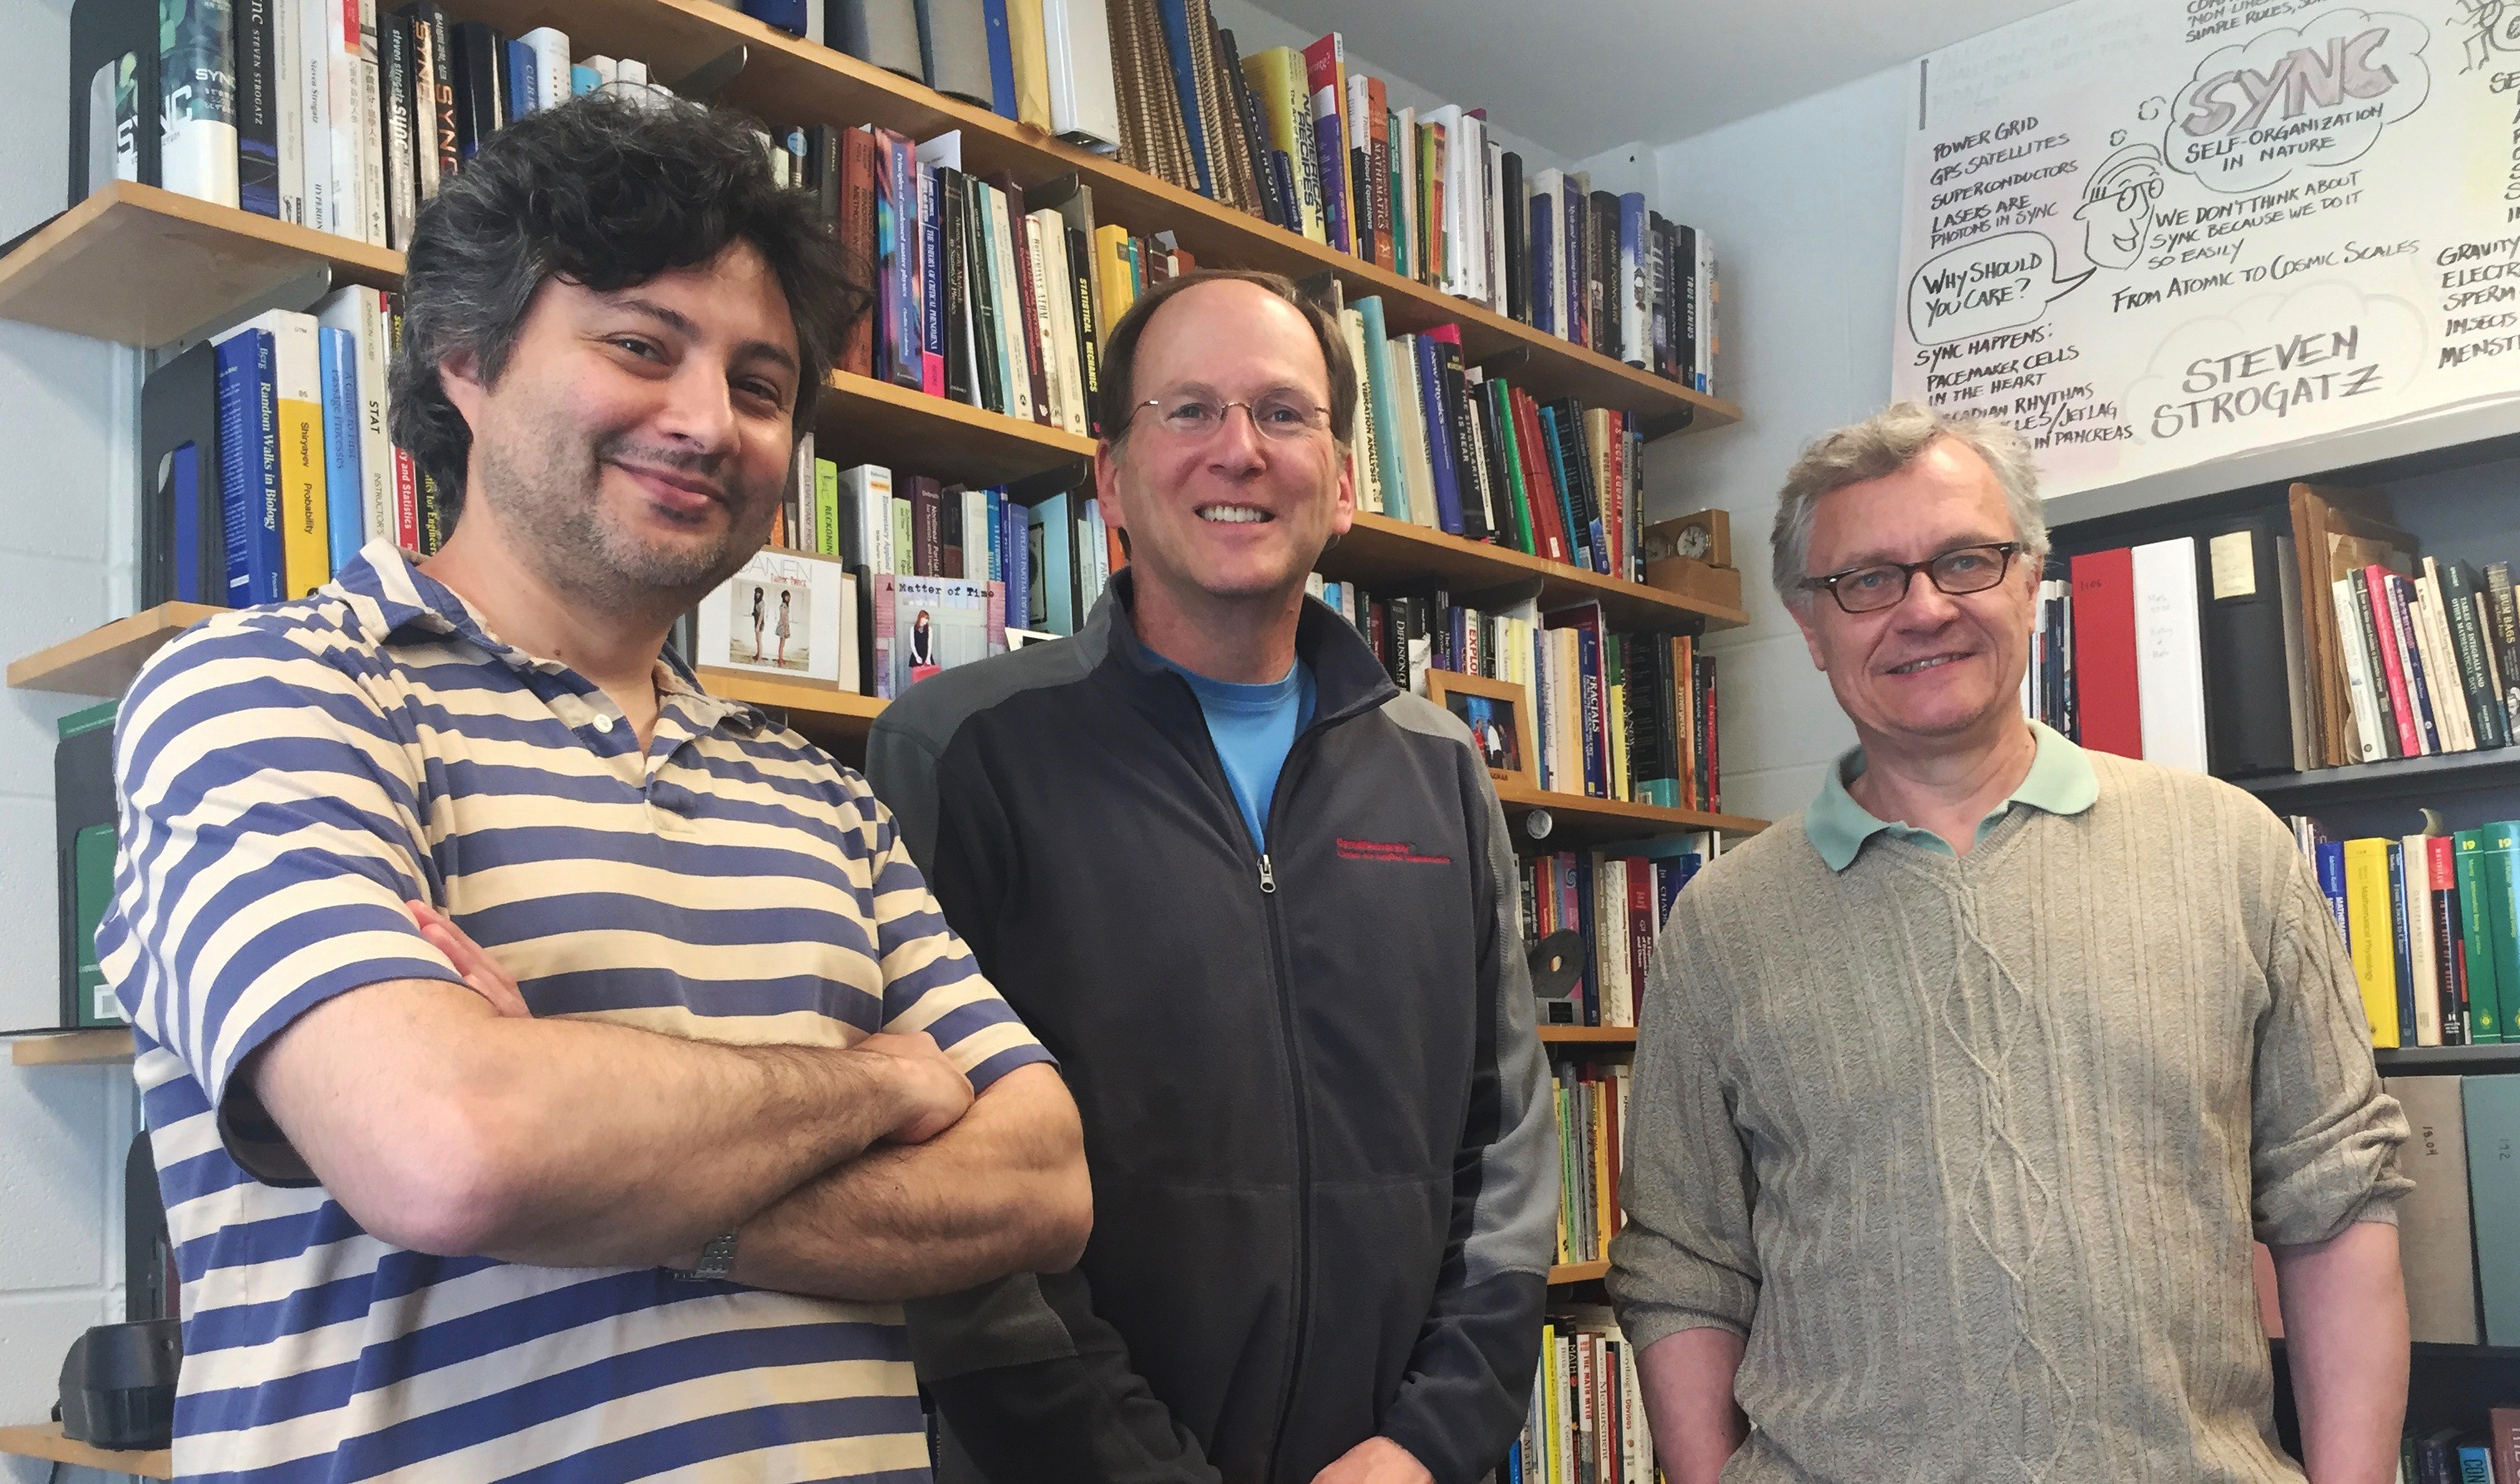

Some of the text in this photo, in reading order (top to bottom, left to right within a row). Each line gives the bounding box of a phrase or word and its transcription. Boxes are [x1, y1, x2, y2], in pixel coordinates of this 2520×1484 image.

[2185, 2, 2296, 42] SIMPLE RULES,
[253, 30, 263, 125] STEVEN STROGATZ
[390, 30, 409, 150] steven strogatz sync
[2179, 27, 2400, 137] SYNC
[311, 89, 319, 123] Strogatz
[435, 84, 458, 175] SYNC
[1933, 116, 2038, 162] POWER GRID
[2185, 102, 2384, 164] SELF-ORGANIZATION
[2222, 136, 2336, 172] IN NATURE
[1260, 150, 1279, 203] THEORY
[1297, 111, 1314, 207] RECIPES
[1303, 93, 1324, 228] NUMERICAL
[1930, 133, 2070, 185] GPS SATELLITES
[315, 184, 323, 230] HYPERION
[898, 191, 906, 201] of
[1364, 154, 1373, 230] About Equations
[1373, 142, 1385, 229] MATHEMATICS
[1931, 160, 2078, 210] SUPERCONDUCTORS
[2156, 170, 2363, 228] WE DON'T THINK ABOUT
[898, 201, 907, 241] condensed
[1931, 202, 2058, 249] PHOTONS IN SYNC
[1932, 195, 2031, 233] LASERS ARE
[2149, 189, 2364, 253] SYNC BECAUSE WE DO IT
[900, 242, 908, 269] matter
[927, 243, 936, 268] THEORY
[928, 269, 936, 278] OF
[2148, 238, 2245, 270] SO EASILY
[2436, 235, 2520, 266] GRAVITY
[899, 269, 909, 297] physics
[928, 280, 936, 308] CRITICAL
[1923, 253, 2042, 297] WHY SHOULD
[2111, 239, 2420, 312] FROM ATOMIC TO COSMIC SCALES
[2443, 285, 2516, 312] SPERM
[1926, 278, 2031, 327] YOU CARE?
[2445, 312, 2518, 337] INSECTS
[928, 309, 938, 350] PHENOMENA
[1079, 278, 1092, 333] STATISTICAL
[1086, 342, 1098, 392] MECHANICS
[1913, 322, 2052, 373] SYNC HAPPENS:
[1927, 345, 2080, 392] PACEMAKER CELLS
[2182, 325, 2359, 394] STEVEN
[1433, 380, 1445, 425] Physics
[1928, 372, 2047, 407] IN THE HEART
[2015, 382, 2094, 414] RHYTHMS
[2151, 363, 2384, 439] STROGATZ
[258, 347, 277, 532] Berg Random Walks in Biology
[369, 400, 380, 434] STAT
[1361, 381, 1378, 484] VIBRATION ANALYSIS
[1457, 415, 1470, 462] IS NEAR
[2035, 425, 2133, 450] IN PANCREAS
[1465, 415, 1479, 492] SINGULARITY
[1603, 452, 1611, 474] MORE
[303, 483, 314, 534] Probability
[374, 472, 385, 535] INSTRUCTOR'S
[400, 464, 413, 529] and Statistics
[1604, 476, 1612, 495] THAN
[426, 496, 438, 557] for Engineers
[1019, 525, 1028, 560] APPLIED
[885, 582, 995, 598] A Matter of Time
[2460, 597, 2485, 688] TABLES OF INTEGRALS AND
[2499, 594, 2515, 644] BUM BAGS
[1397, 621, 1407, 685] DIFFUSION OF
[2452, 598, 2477, 695] OTHER MATHEMATICAL DATA
[1590, 676, 1599, 733] FRACTALS
[1678, 686, 1686, 738] Synergetics
[2414, 890, 2420, 903] ON
[2362, 886, 2374, 981] Mathematical Physiology
[2444, 950, 2449, 958] OF
[2421, 1125, 2435, 1157] 18.04
[1569, 1344, 1577, 1373] MATH
[1624, 1343, 1632, 1388] Everything
[1626, 1388, 1632, 1397] Is
[1599, 1381, 1608, 1460] Measurement
